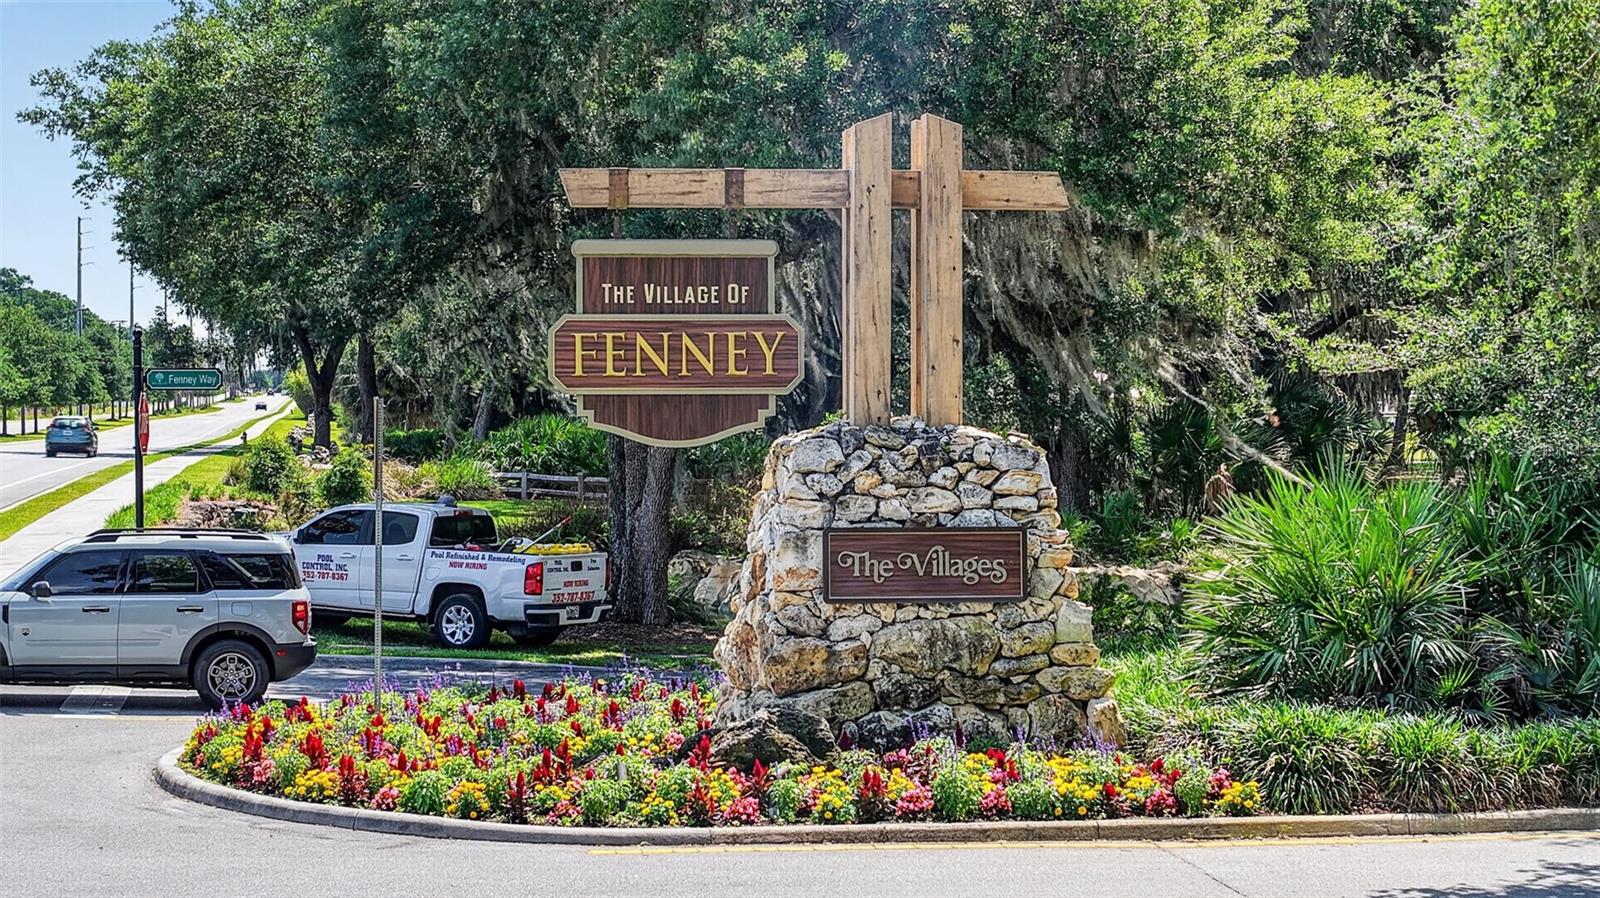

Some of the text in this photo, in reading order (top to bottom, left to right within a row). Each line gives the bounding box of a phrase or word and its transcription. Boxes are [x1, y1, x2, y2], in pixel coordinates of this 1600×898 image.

[602, 283, 750, 304] THE VILLAGE OF
[571, 331, 788, 377] FENNEY
[168, 374, 217, 386] Fenney Way
[317, 554, 334, 562] POOL
[430, 551, 444, 559] Pool
[446, 551, 480, 561] Refinished
[487, 554, 526, 565] Remodeling
[448, 561, 488, 570] NOW HIRING
[837, 545, 1008, 585] The Villages
[302, 571, 348, 581] 352-787-8367
[552, 591, 595, 603] 352-787-8367
